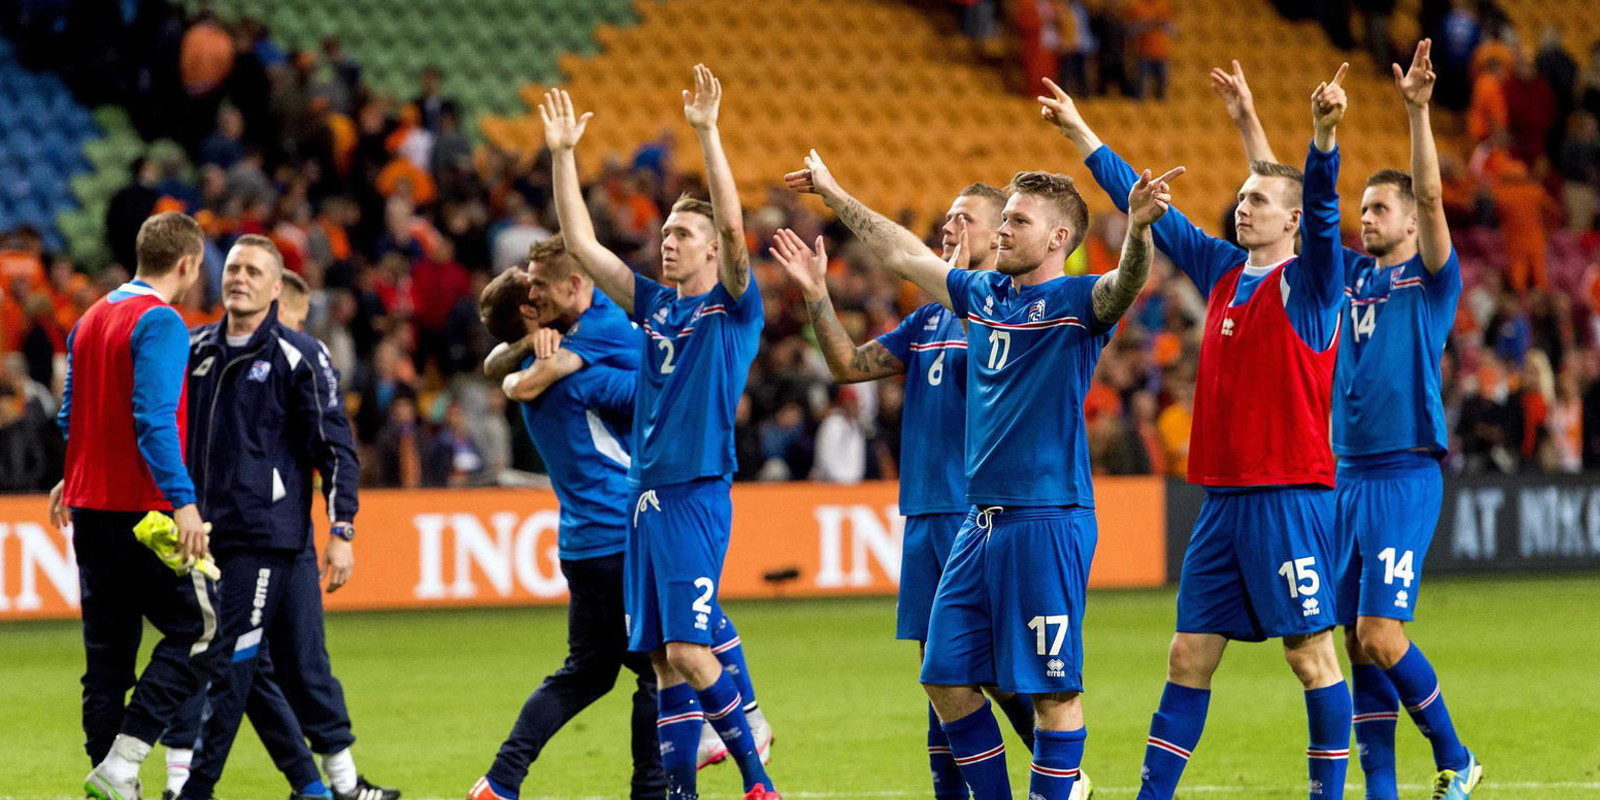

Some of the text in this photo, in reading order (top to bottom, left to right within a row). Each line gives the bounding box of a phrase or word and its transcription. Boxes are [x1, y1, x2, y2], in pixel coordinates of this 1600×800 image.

[1351, 303, 1376, 342] 14
[658, 338, 676, 374] 2
[927, 351, 946, 386] 6
[988, 329, 1011, 370] 17
[1453, 487, 1504, 559] AT
[413, 510, 570, 599] ING
[1377, 547, 1415, 588] 14
[692, 576, 714, 614] 2
[1277, 556, 1320, 599] 15
[1027, 614, 1068, 656] 17
